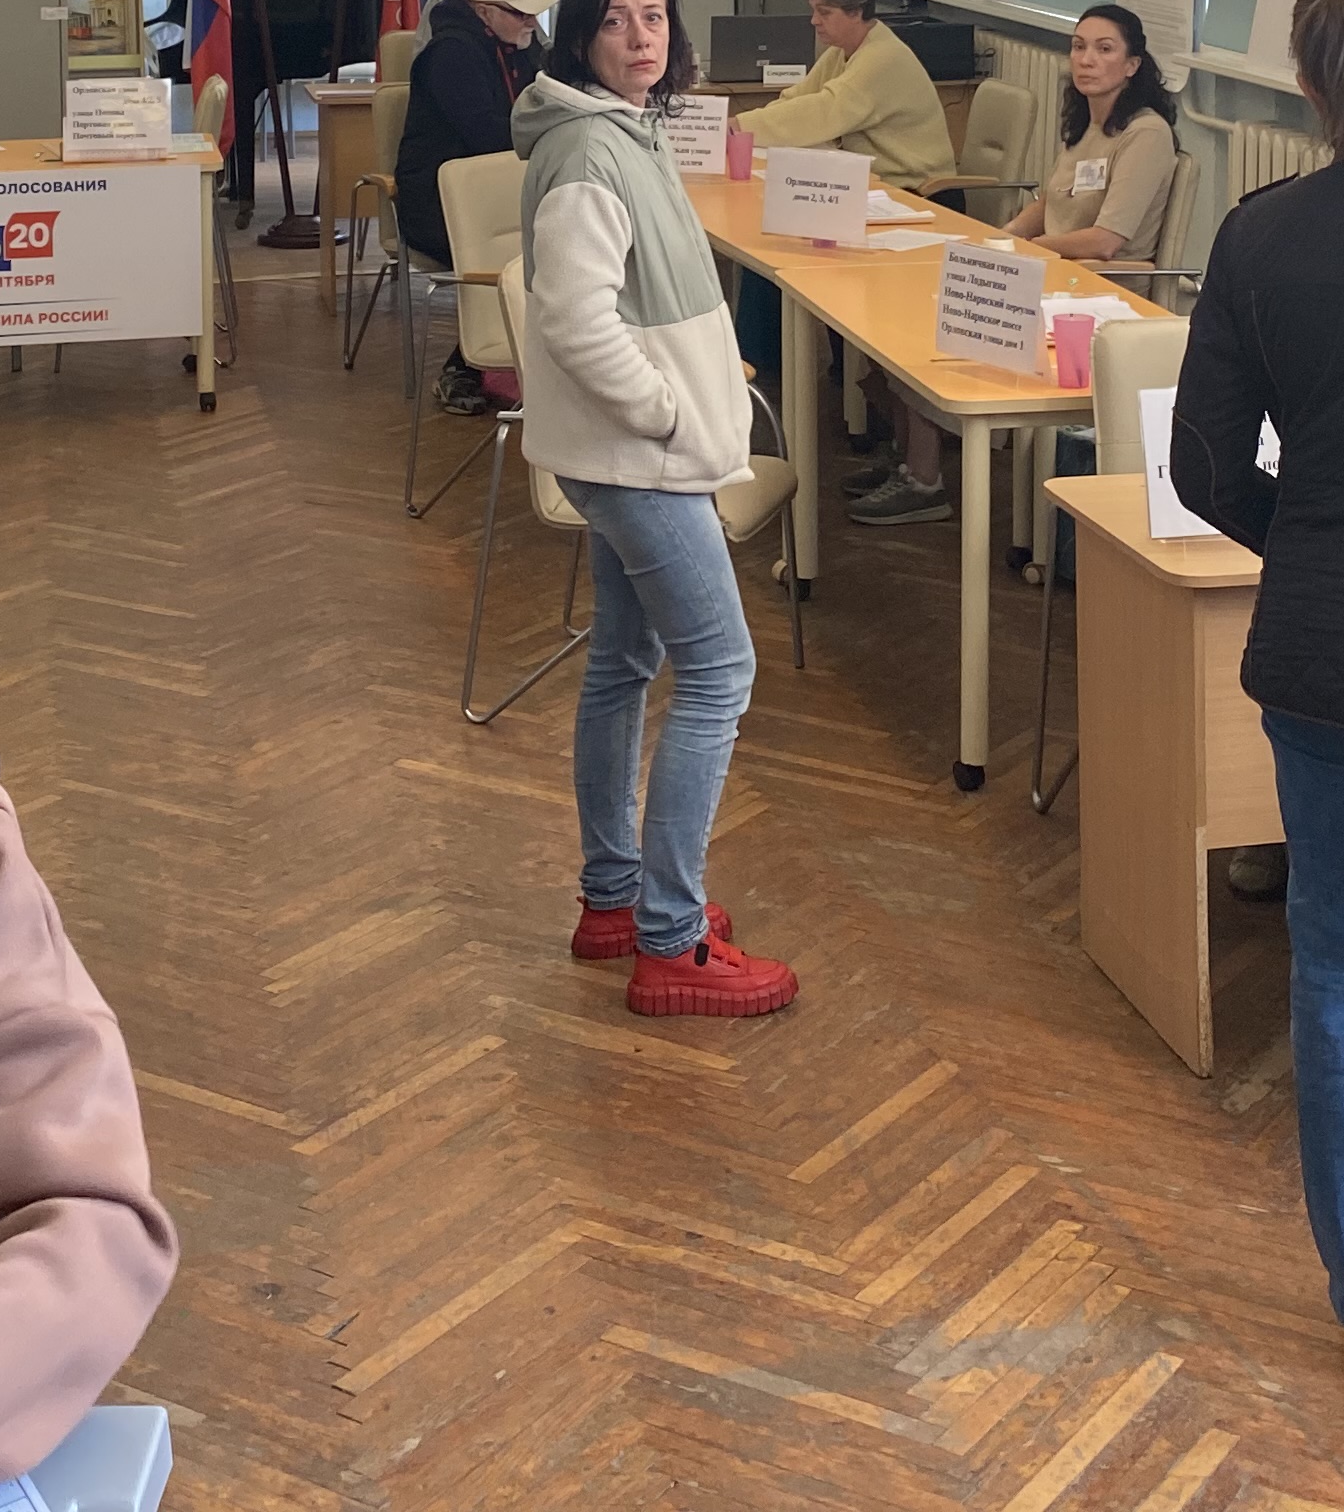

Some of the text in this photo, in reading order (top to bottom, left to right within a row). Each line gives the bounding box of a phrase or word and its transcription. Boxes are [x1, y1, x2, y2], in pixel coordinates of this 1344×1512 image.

[8, 222, 50, 249] 20
[948, 251, 1019, 276] Больничная горка
[944, 286, 1005, 309] Ново-Нарвский
[38, 309, 109, 324] РОССИИ!
[942, 303, 1001, 326] Ново-Нарвское
